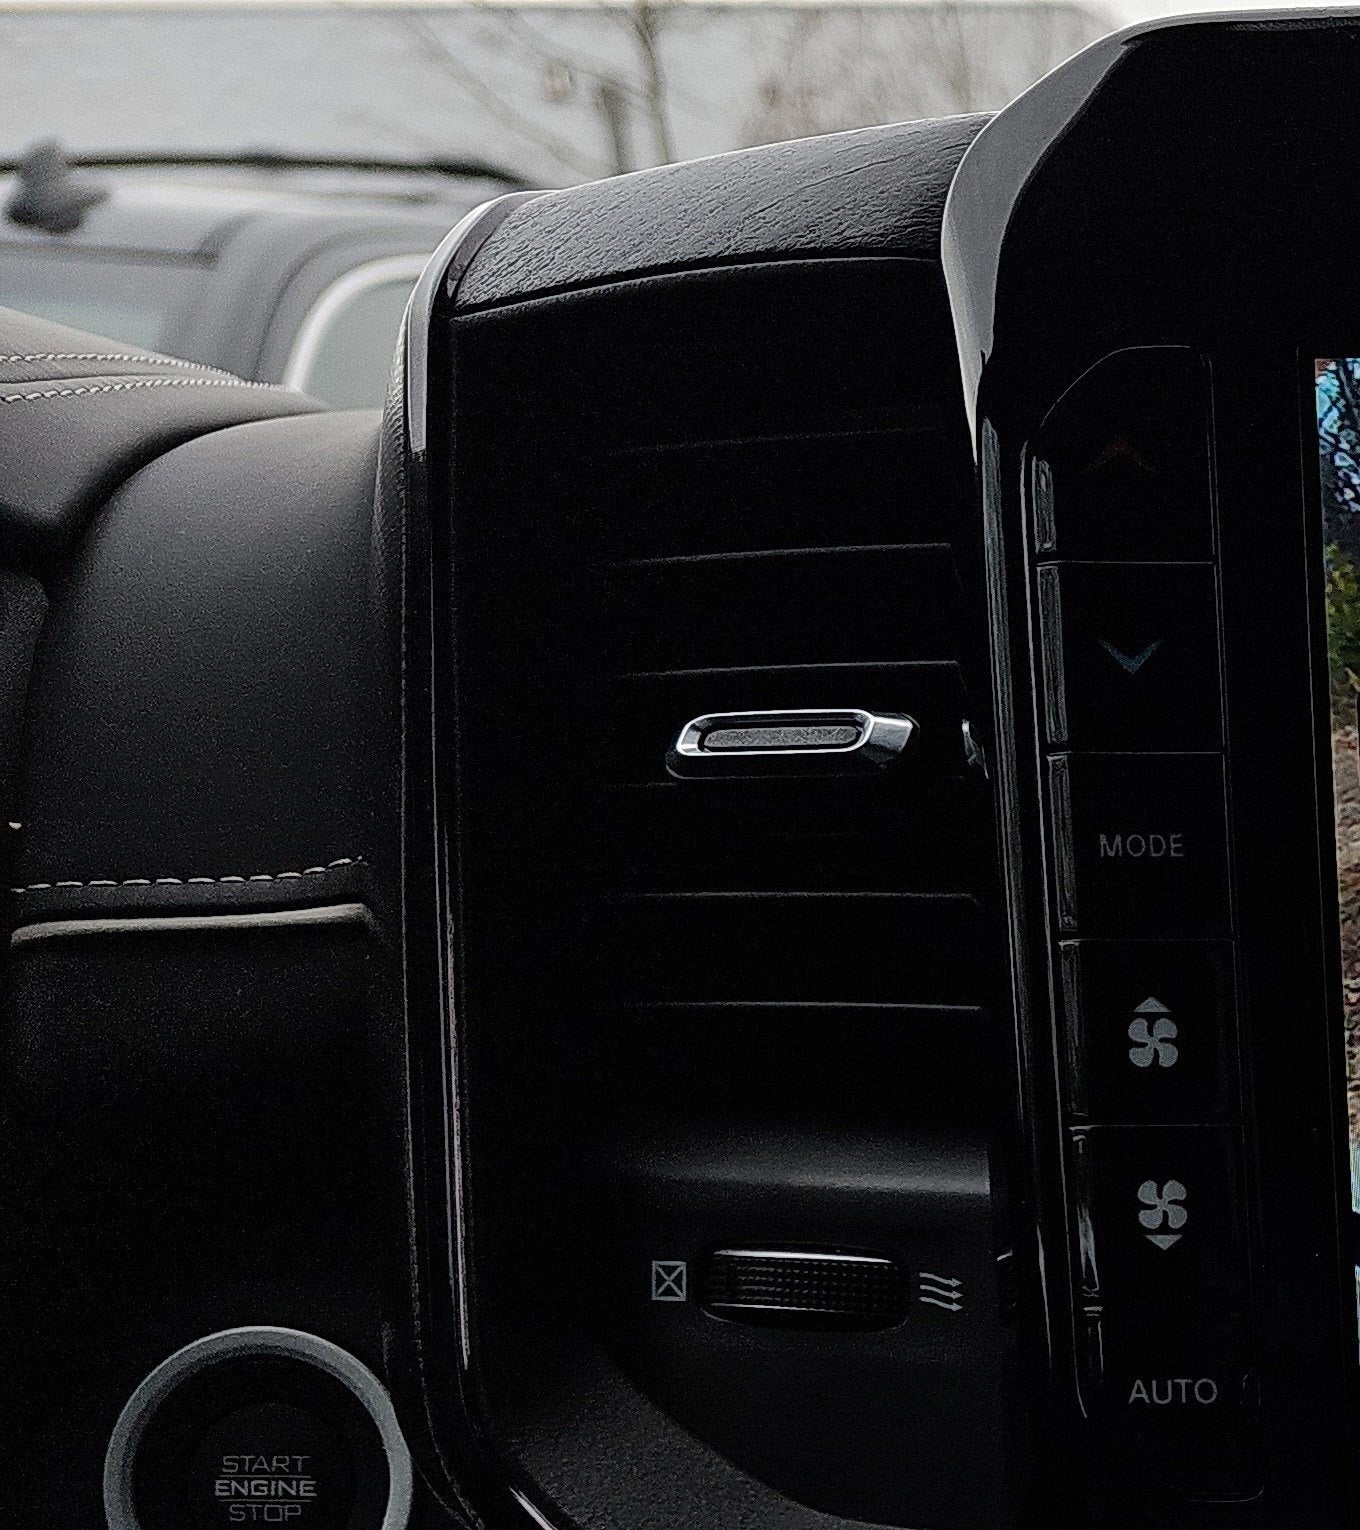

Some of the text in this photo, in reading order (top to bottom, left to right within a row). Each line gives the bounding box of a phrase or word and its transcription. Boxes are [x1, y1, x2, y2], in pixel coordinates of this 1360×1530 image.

[1099, 833, 1184, 860] MODE
[1128, 1377, 1218, 1406] AUTO
[221, 1455, 313, 1474] START
[213, 1479, 318, 1498] ENGINE
[229, 1503, 303, 1523] STOP
